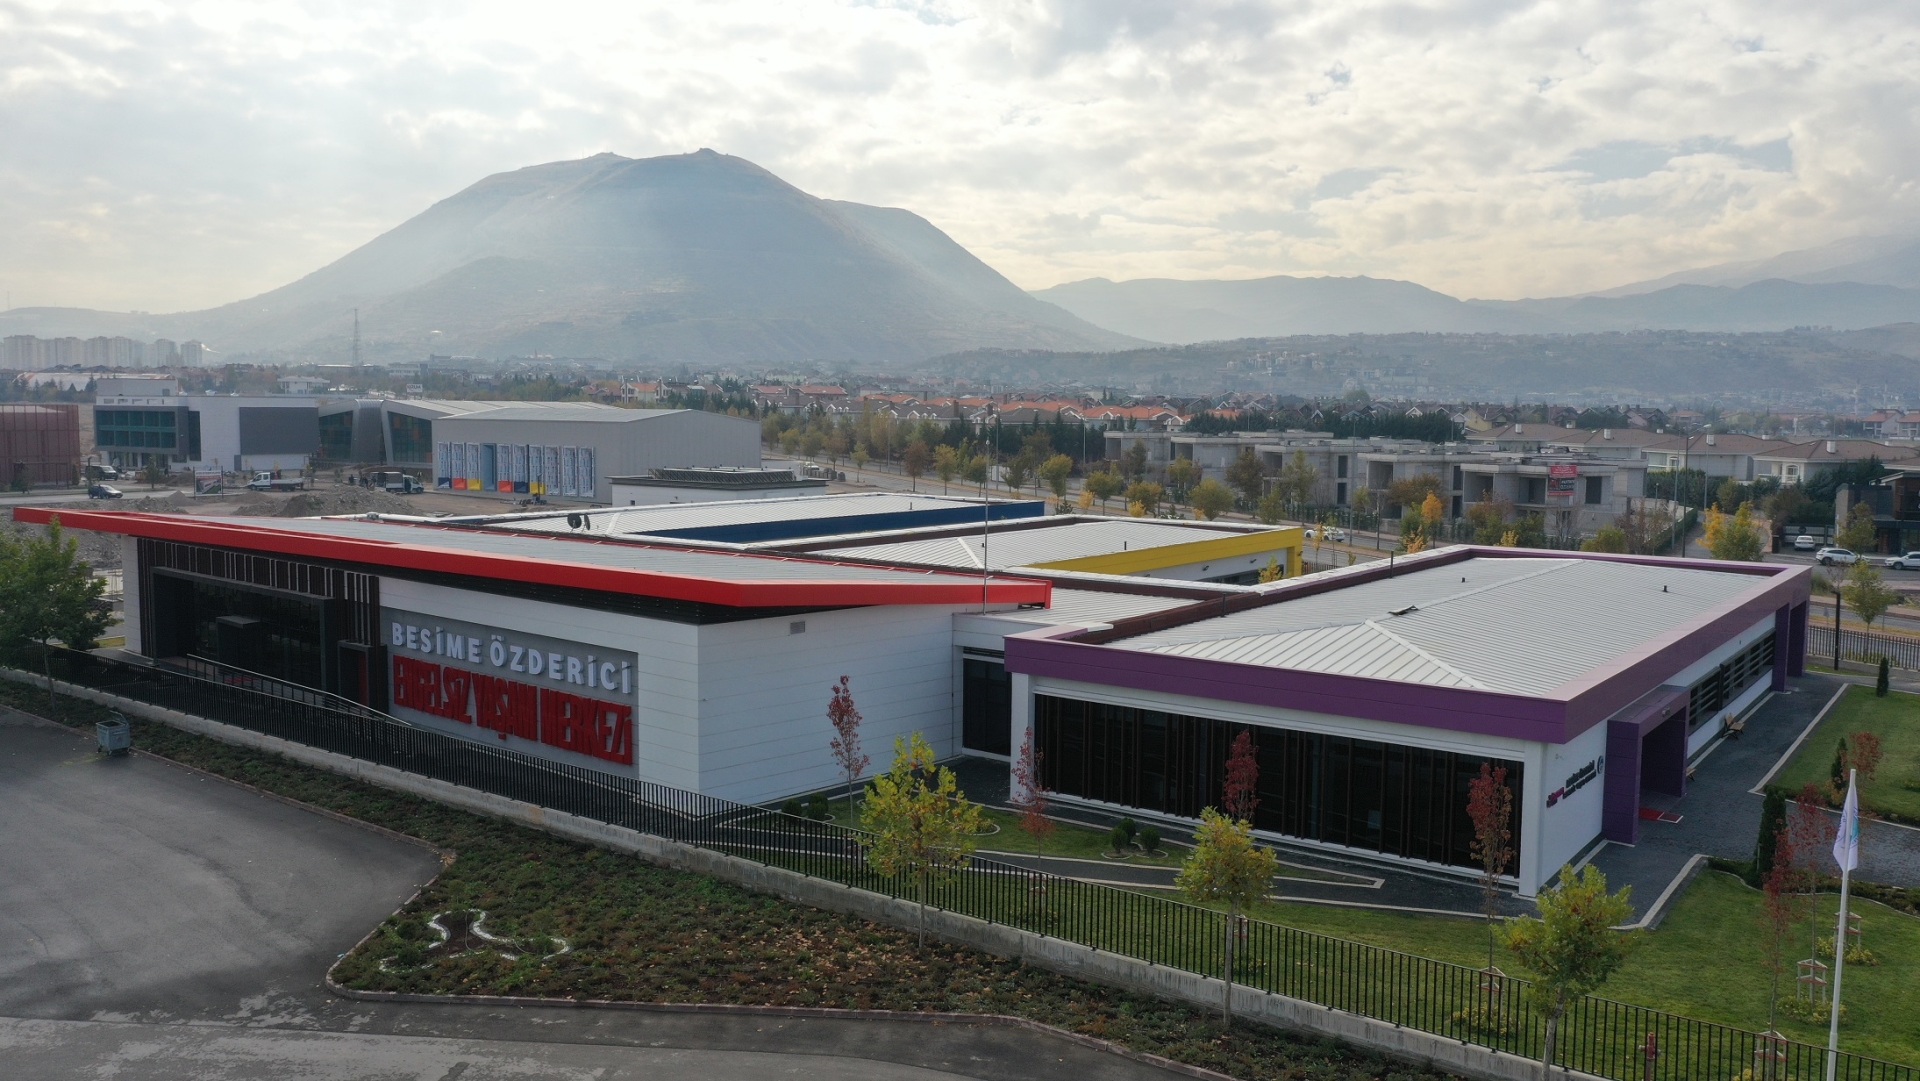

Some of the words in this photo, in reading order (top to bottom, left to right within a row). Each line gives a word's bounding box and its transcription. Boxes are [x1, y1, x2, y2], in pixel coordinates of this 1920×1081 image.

[392, 622, 483, 664] BESİME
[489, 634, 632, 694] ÖZDERİCİ
[393, 654, 472, 725] ENGELSİZ
[472, 672, 538, 741] YAŞAM
[540, 688, 633, 766] MERKEZİ
